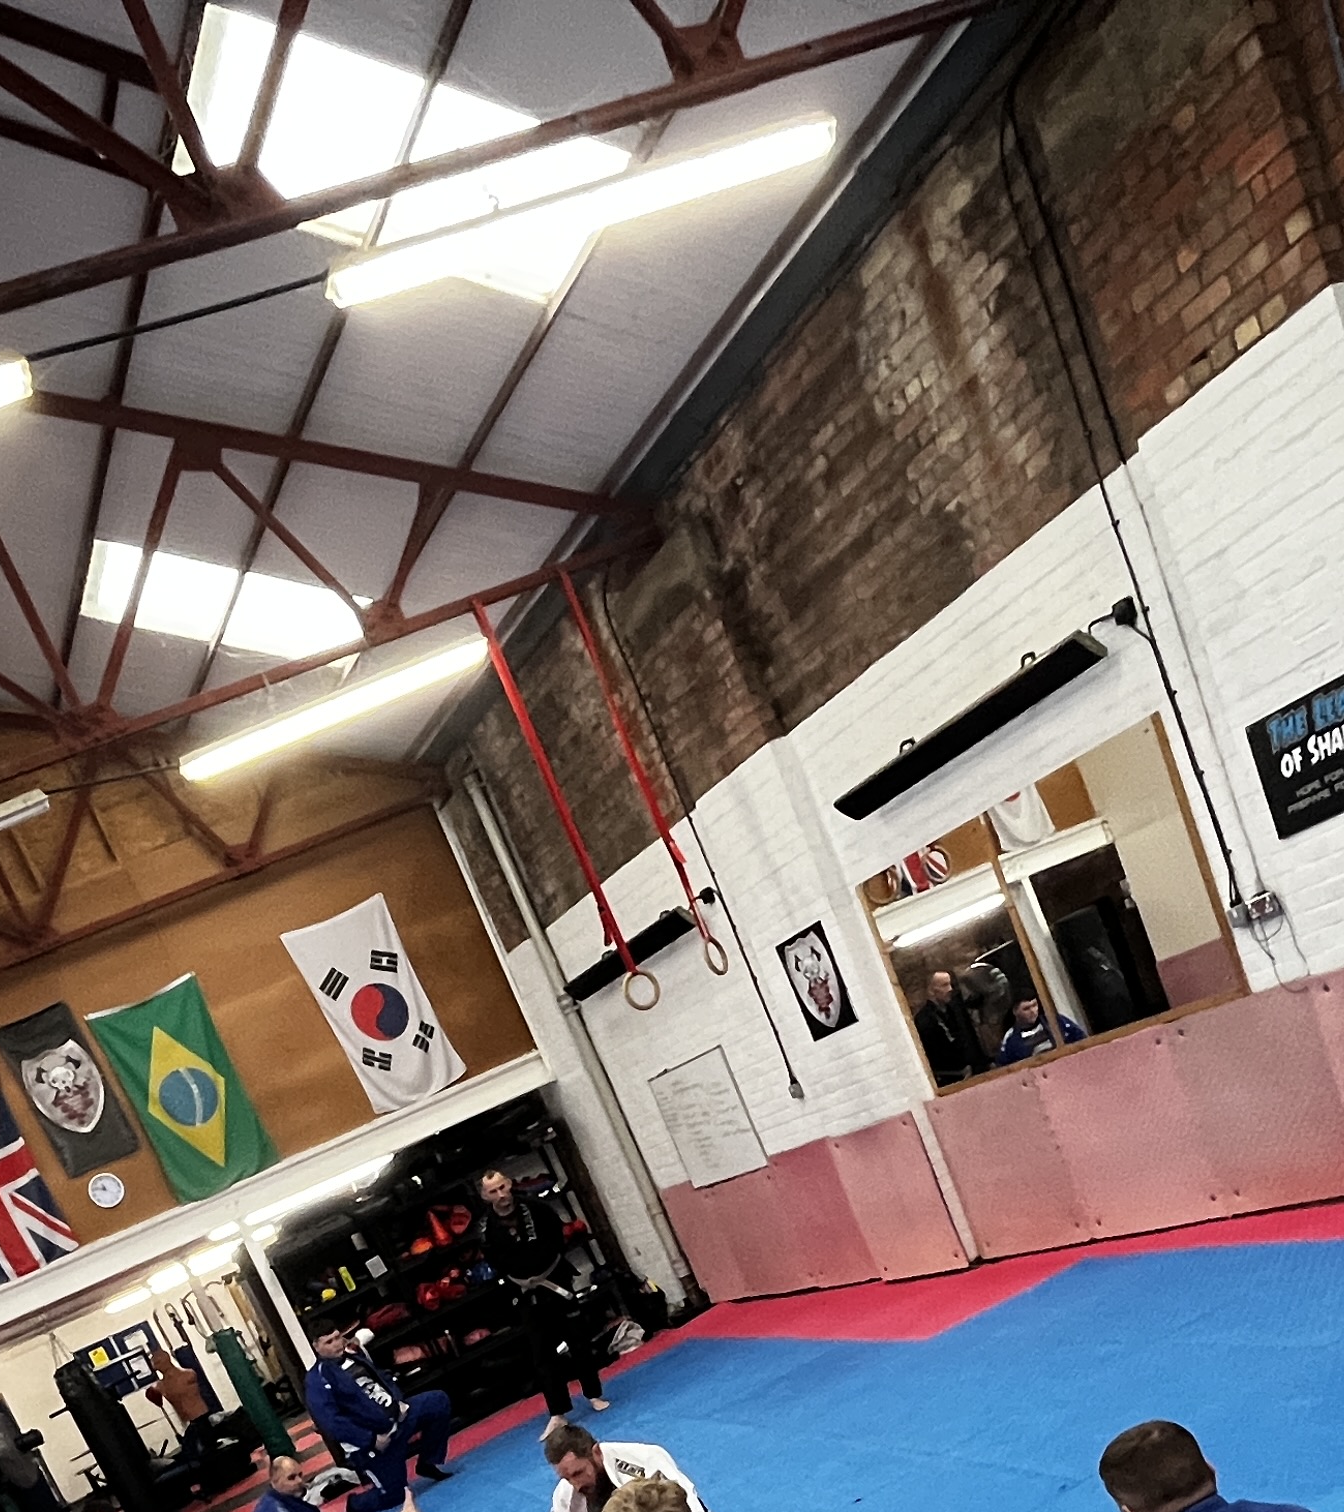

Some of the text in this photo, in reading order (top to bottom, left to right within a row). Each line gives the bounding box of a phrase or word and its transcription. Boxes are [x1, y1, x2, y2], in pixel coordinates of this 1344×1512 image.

[1267, 706, 1308, 754] THE
[1280, 746, 1303, 778] OF
[1287, 788, 1332, 814] PREPARE
[1295, 779, 1322, 798] HOPE
